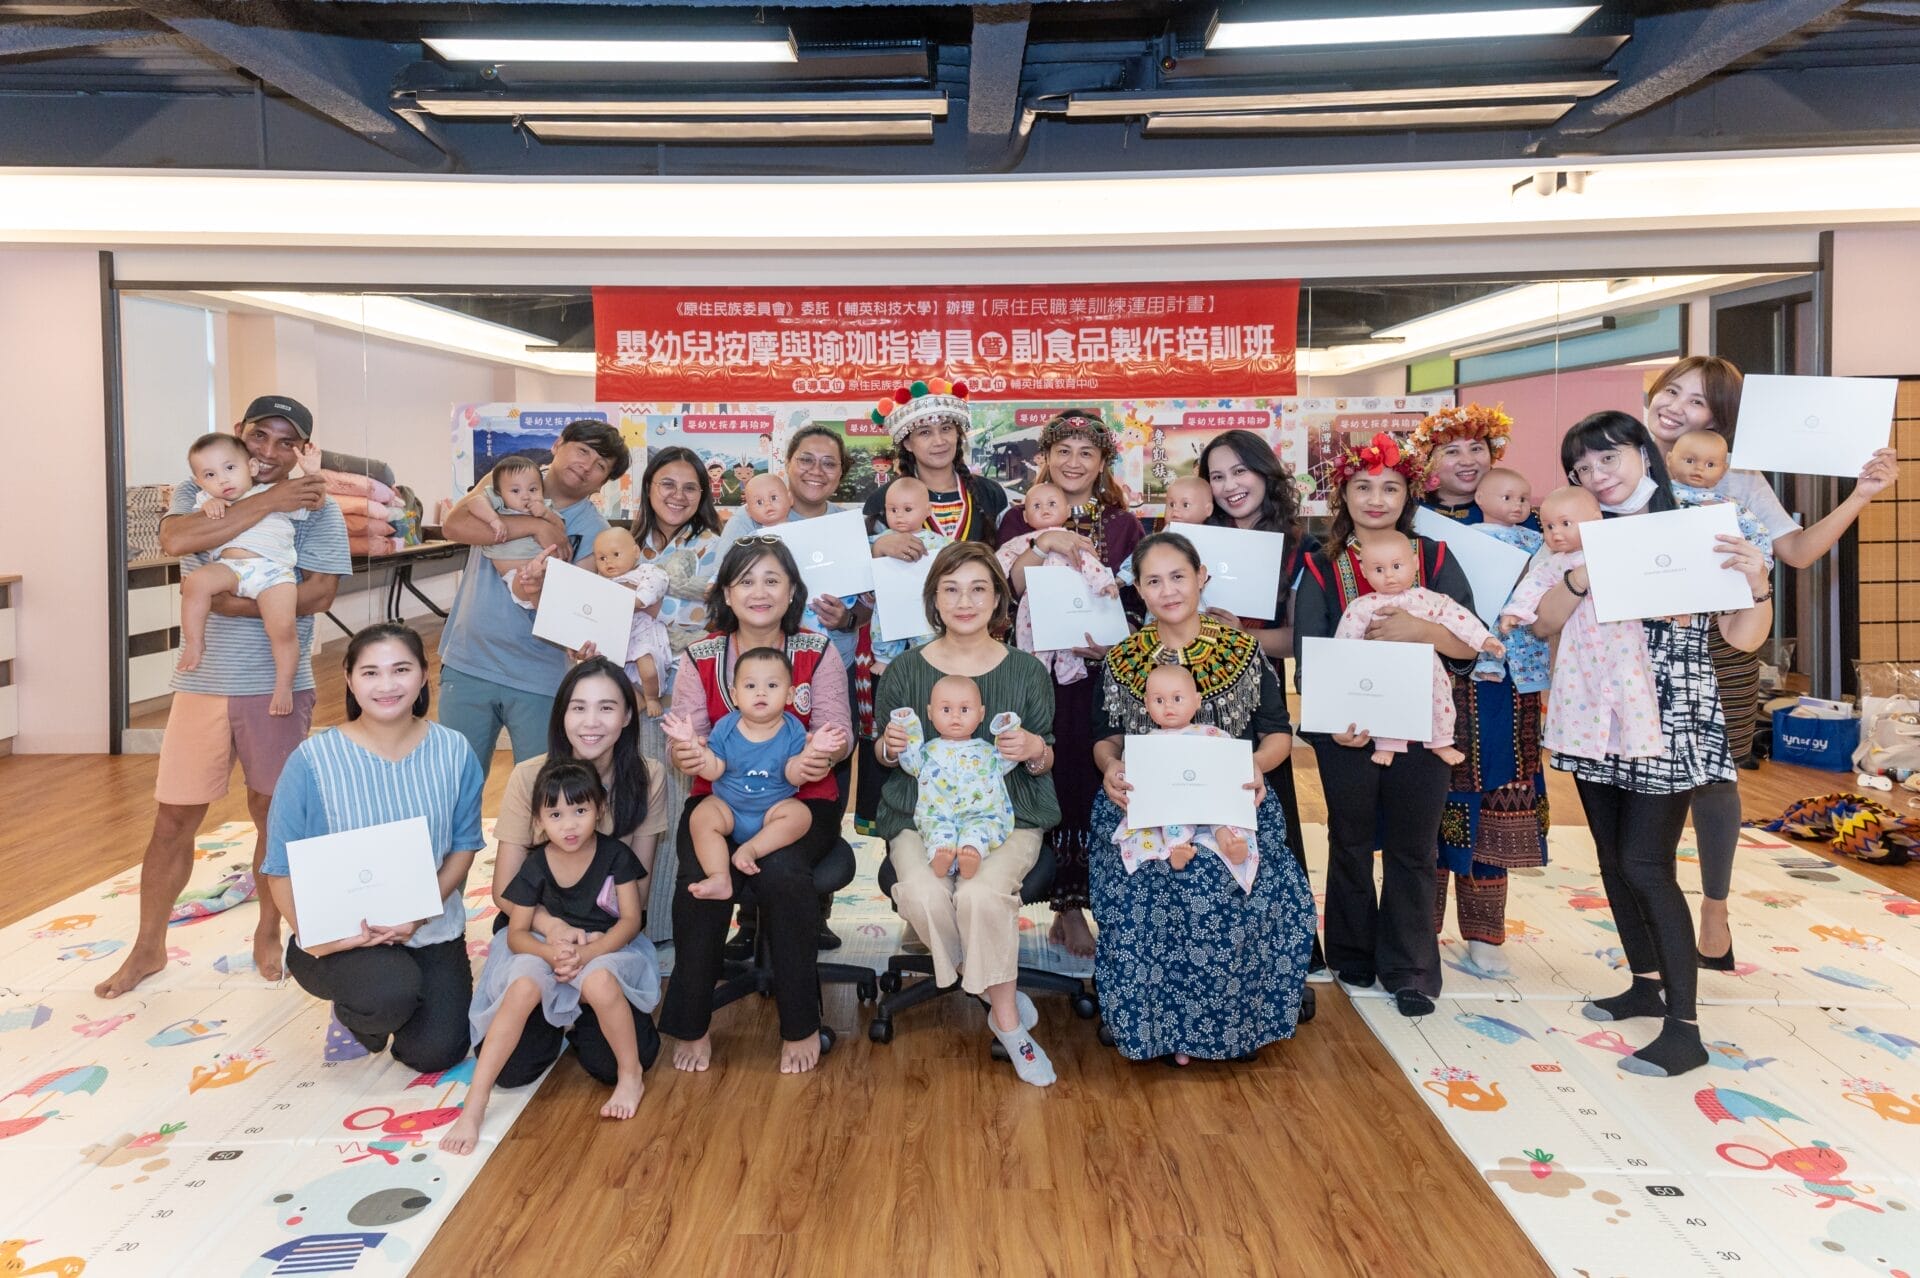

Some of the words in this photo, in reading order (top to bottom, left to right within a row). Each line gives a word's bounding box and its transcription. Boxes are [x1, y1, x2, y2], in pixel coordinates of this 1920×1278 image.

[849, 380, 913, 391] 原住民族委員
[956, 376, 1006, 392] 辦單位
[1152, 429, 1168, 477] 魯凱族
[1578, 1108, 1598, 1116] 80
[1601, 1132, 1622, 1140] 70
[214, 1151, 235, 1160] 50
[1626, 1158, 1648, 1166] 60
[184, 1179, 206, 1188] 40
[1654, 1186, 1676, 1196] 50
[151, 1209, 174, 1219] 30
[1685, 1217, 1707, 1227] 40
[115, 1242, 140, 1252] 20
[1716, 1250, 1741, 1261] 30
